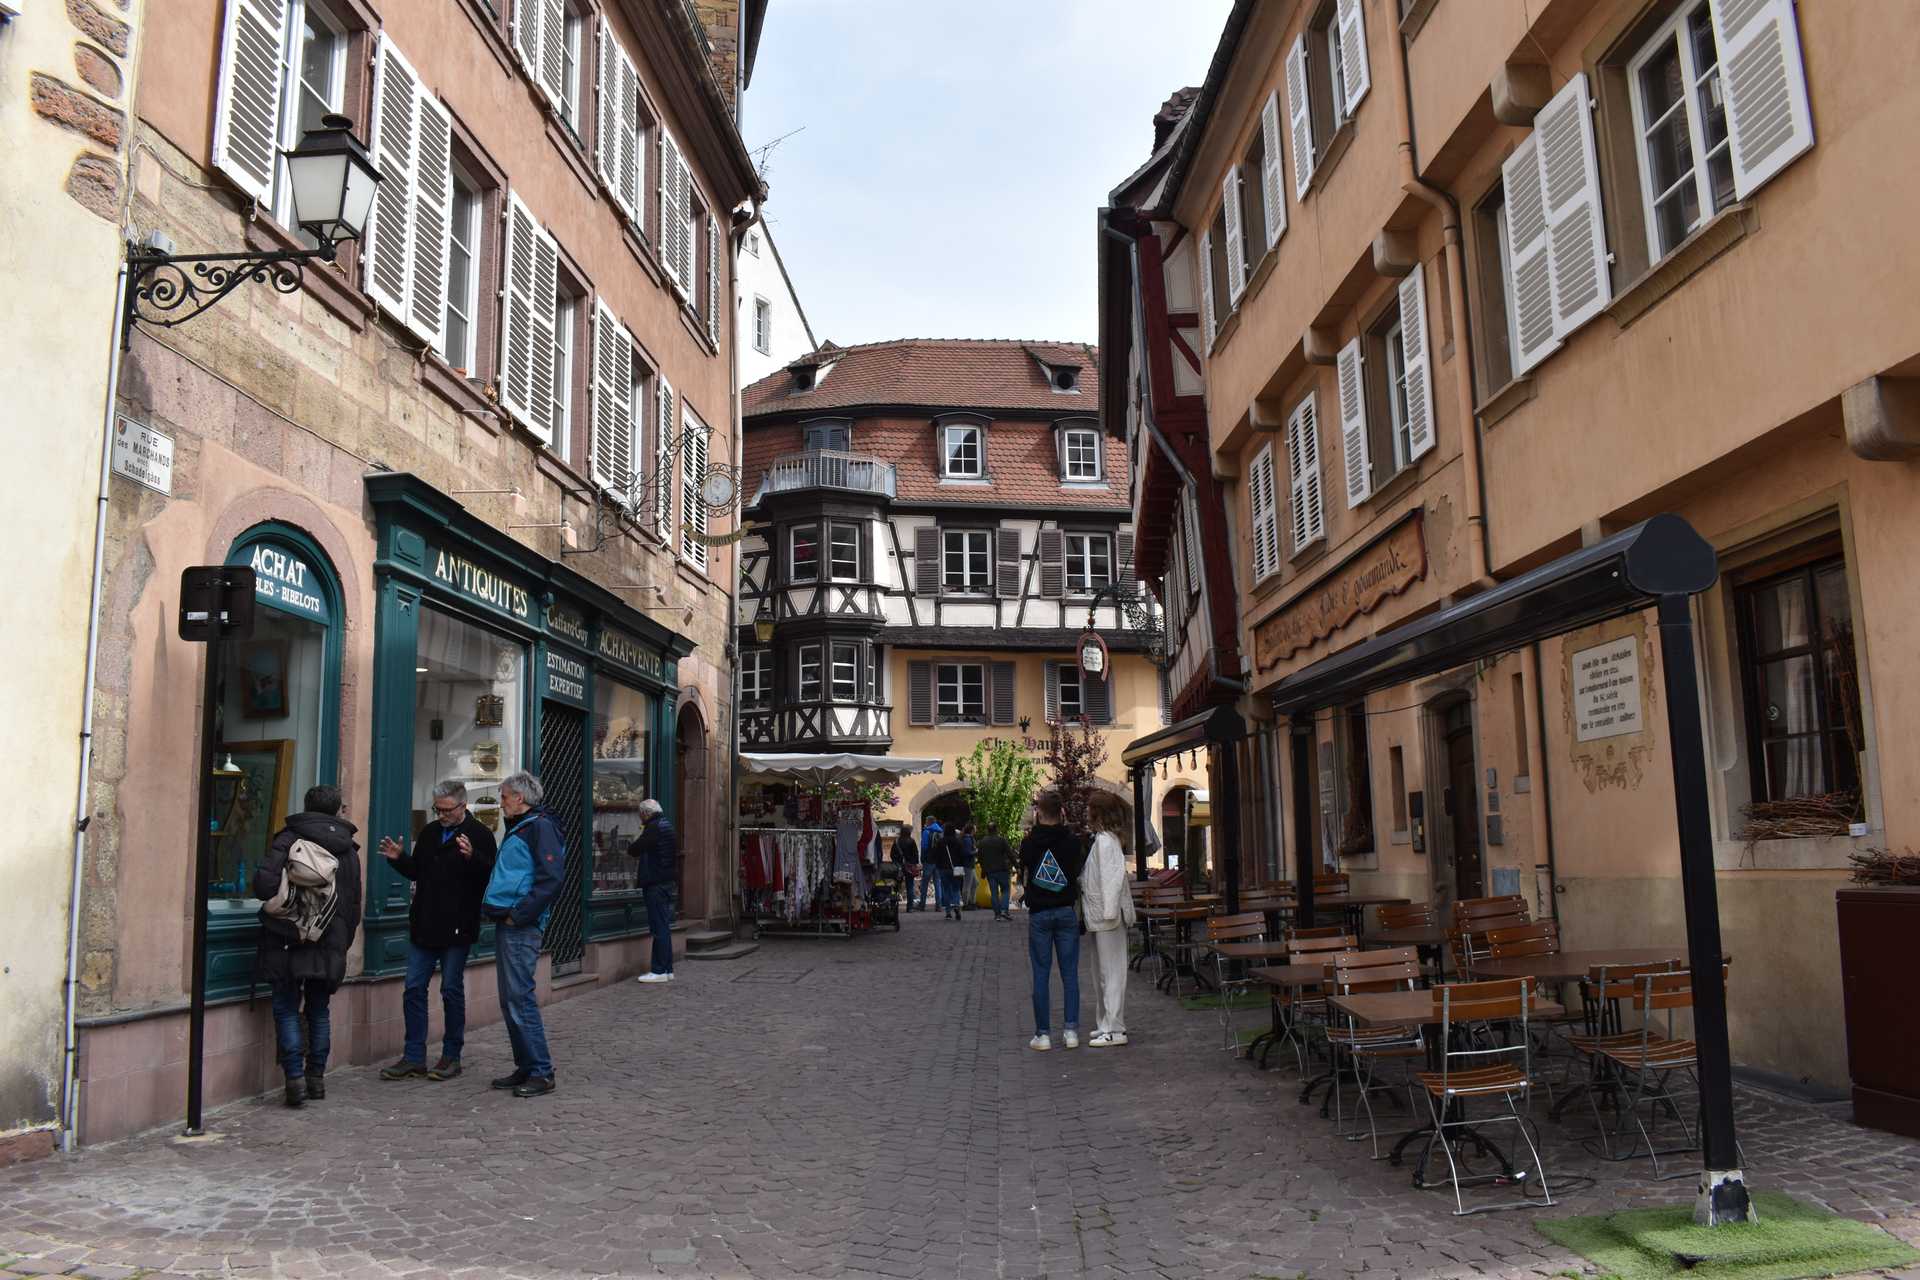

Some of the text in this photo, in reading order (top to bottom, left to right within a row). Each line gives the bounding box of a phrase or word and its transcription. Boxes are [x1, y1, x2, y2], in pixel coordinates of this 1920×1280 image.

[117, 438, 170, 468] des MARCHANDS
[140, 432, 158, 447] RUE
[250, 545, 307, 588] ACHAT
[435, 550, 528, 618] ANTIQUITES
[281, 586, 320, 613] BIBELOTS
[547, 651, 585, 680] ESTIMATION
[550, 674, 584, 700] EXPERTISE
[983, 737, 1016, 751] Chz
